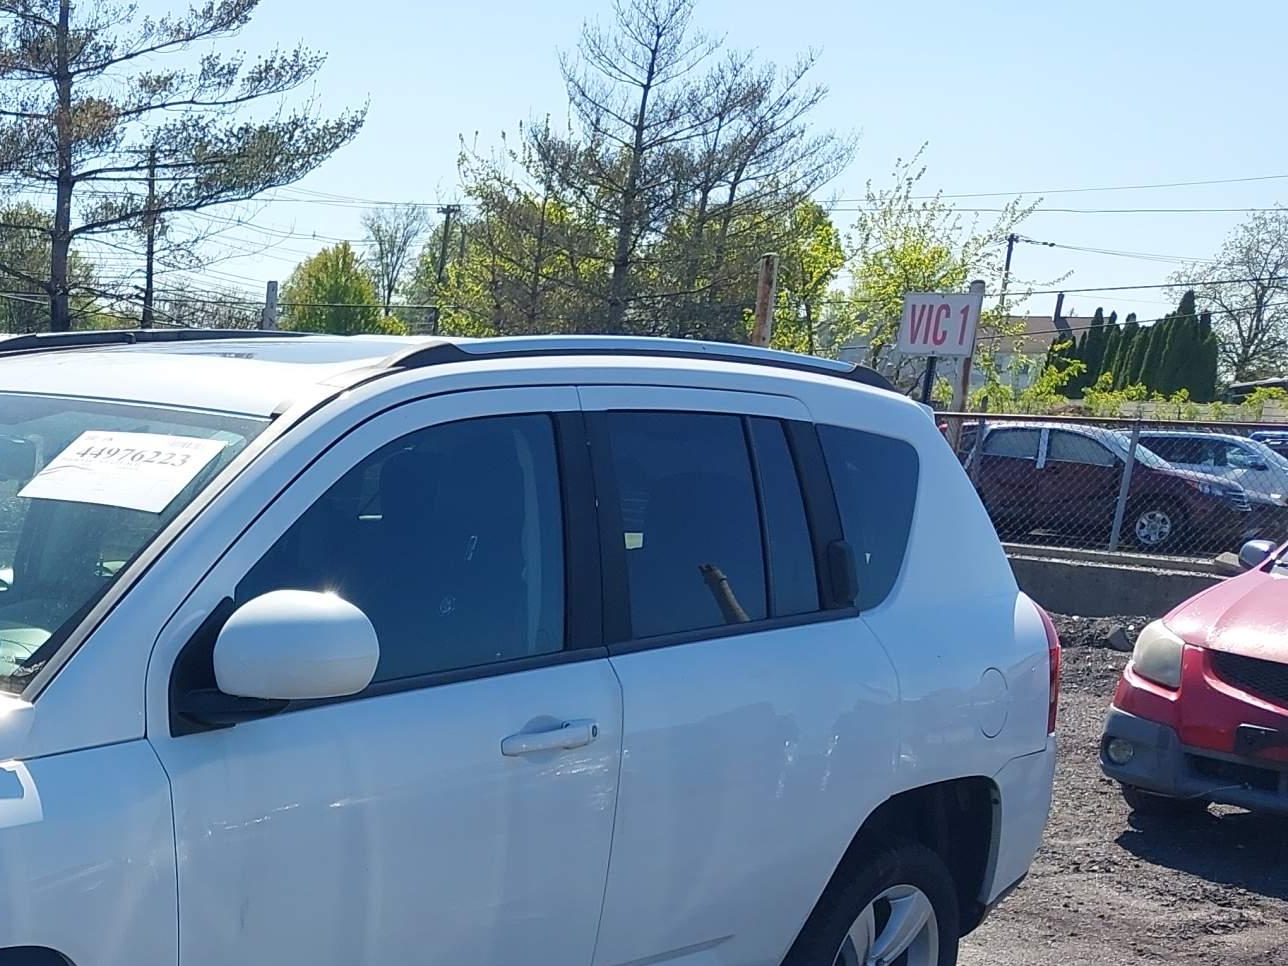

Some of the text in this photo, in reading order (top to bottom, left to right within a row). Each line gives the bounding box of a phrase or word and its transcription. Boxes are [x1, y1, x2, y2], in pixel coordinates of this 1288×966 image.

[910, 303, 970, 346] VIC 1
[76, 446, 191, 467] 44976223
